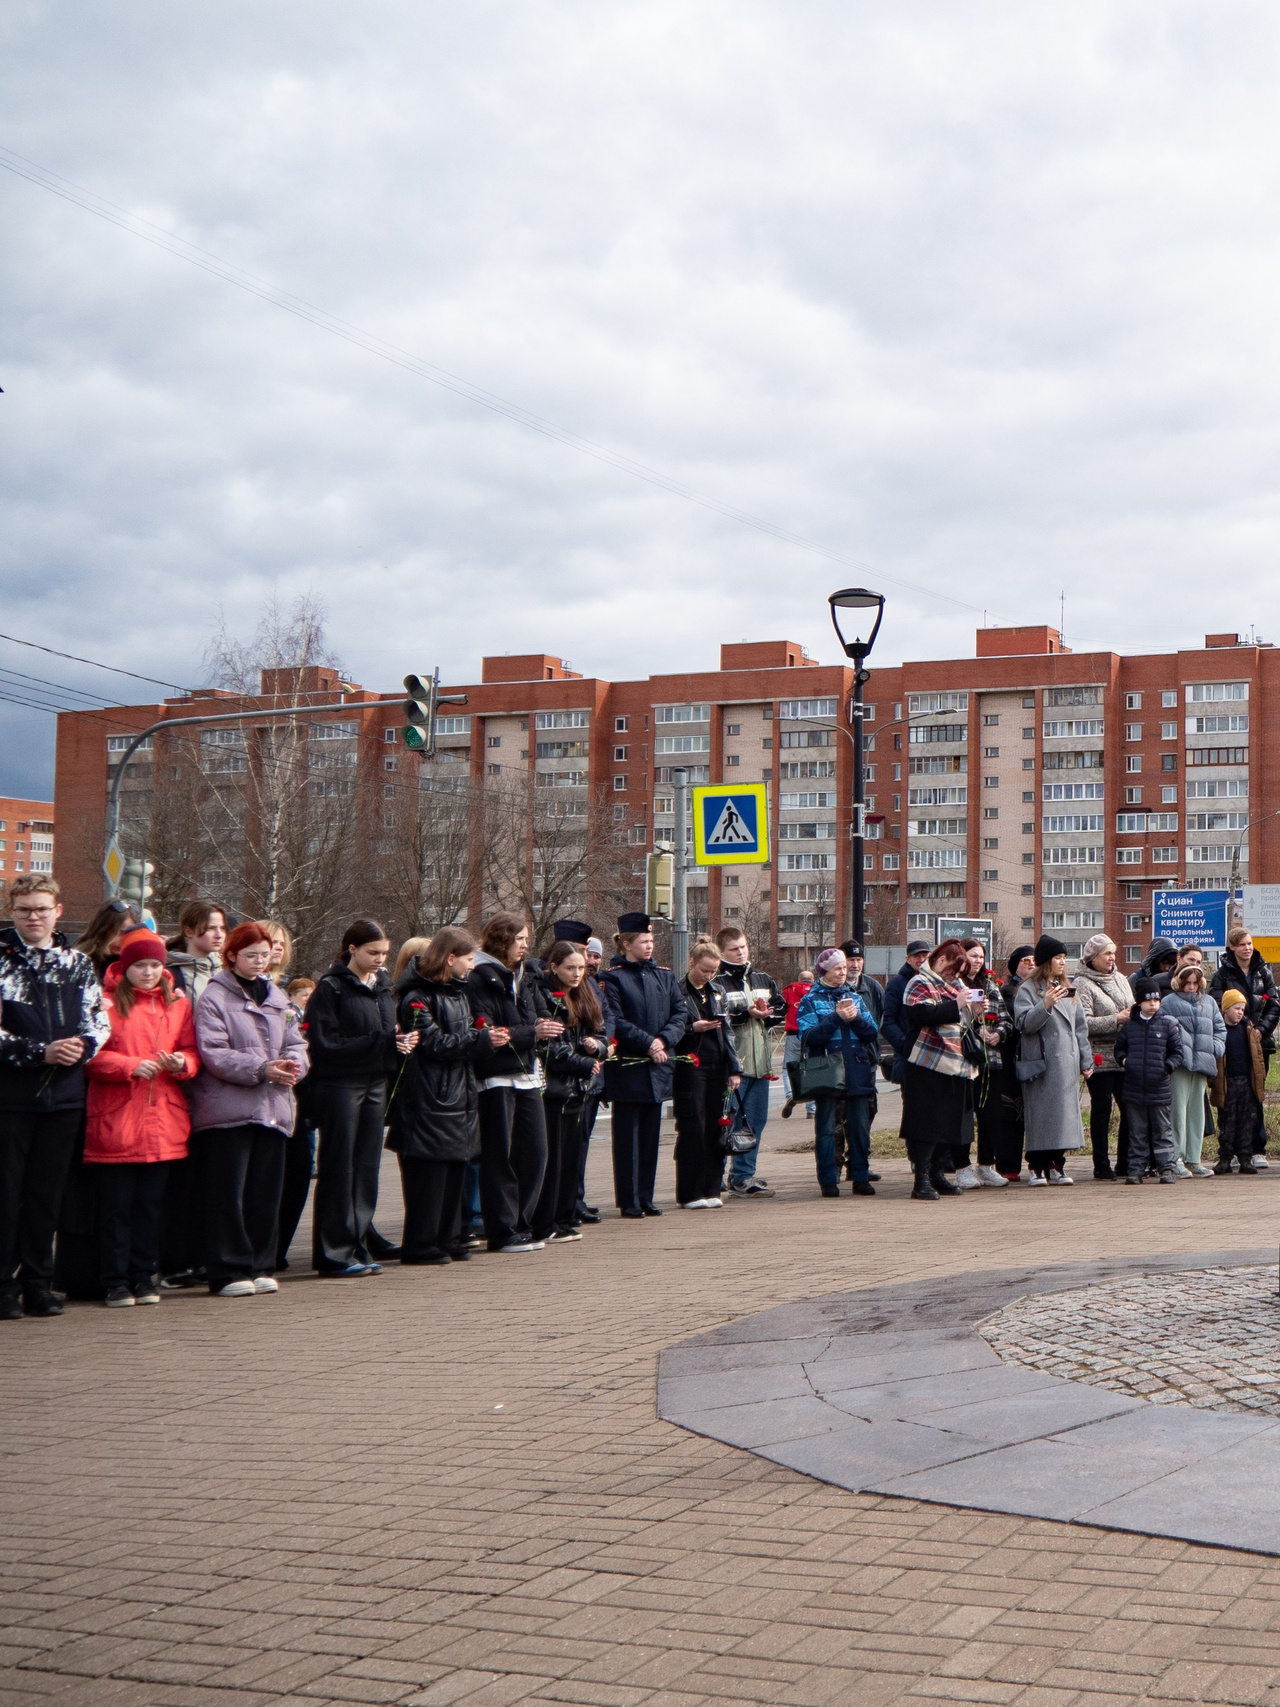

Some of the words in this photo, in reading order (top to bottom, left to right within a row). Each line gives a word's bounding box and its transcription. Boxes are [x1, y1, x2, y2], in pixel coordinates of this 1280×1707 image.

[1167, 898, 1193, 906] циан
[1160, 909, 1204, 918] Снимите
[1160, 919, 1206, 928] квартиру
[1172, 929, 1214, 937] реальным
